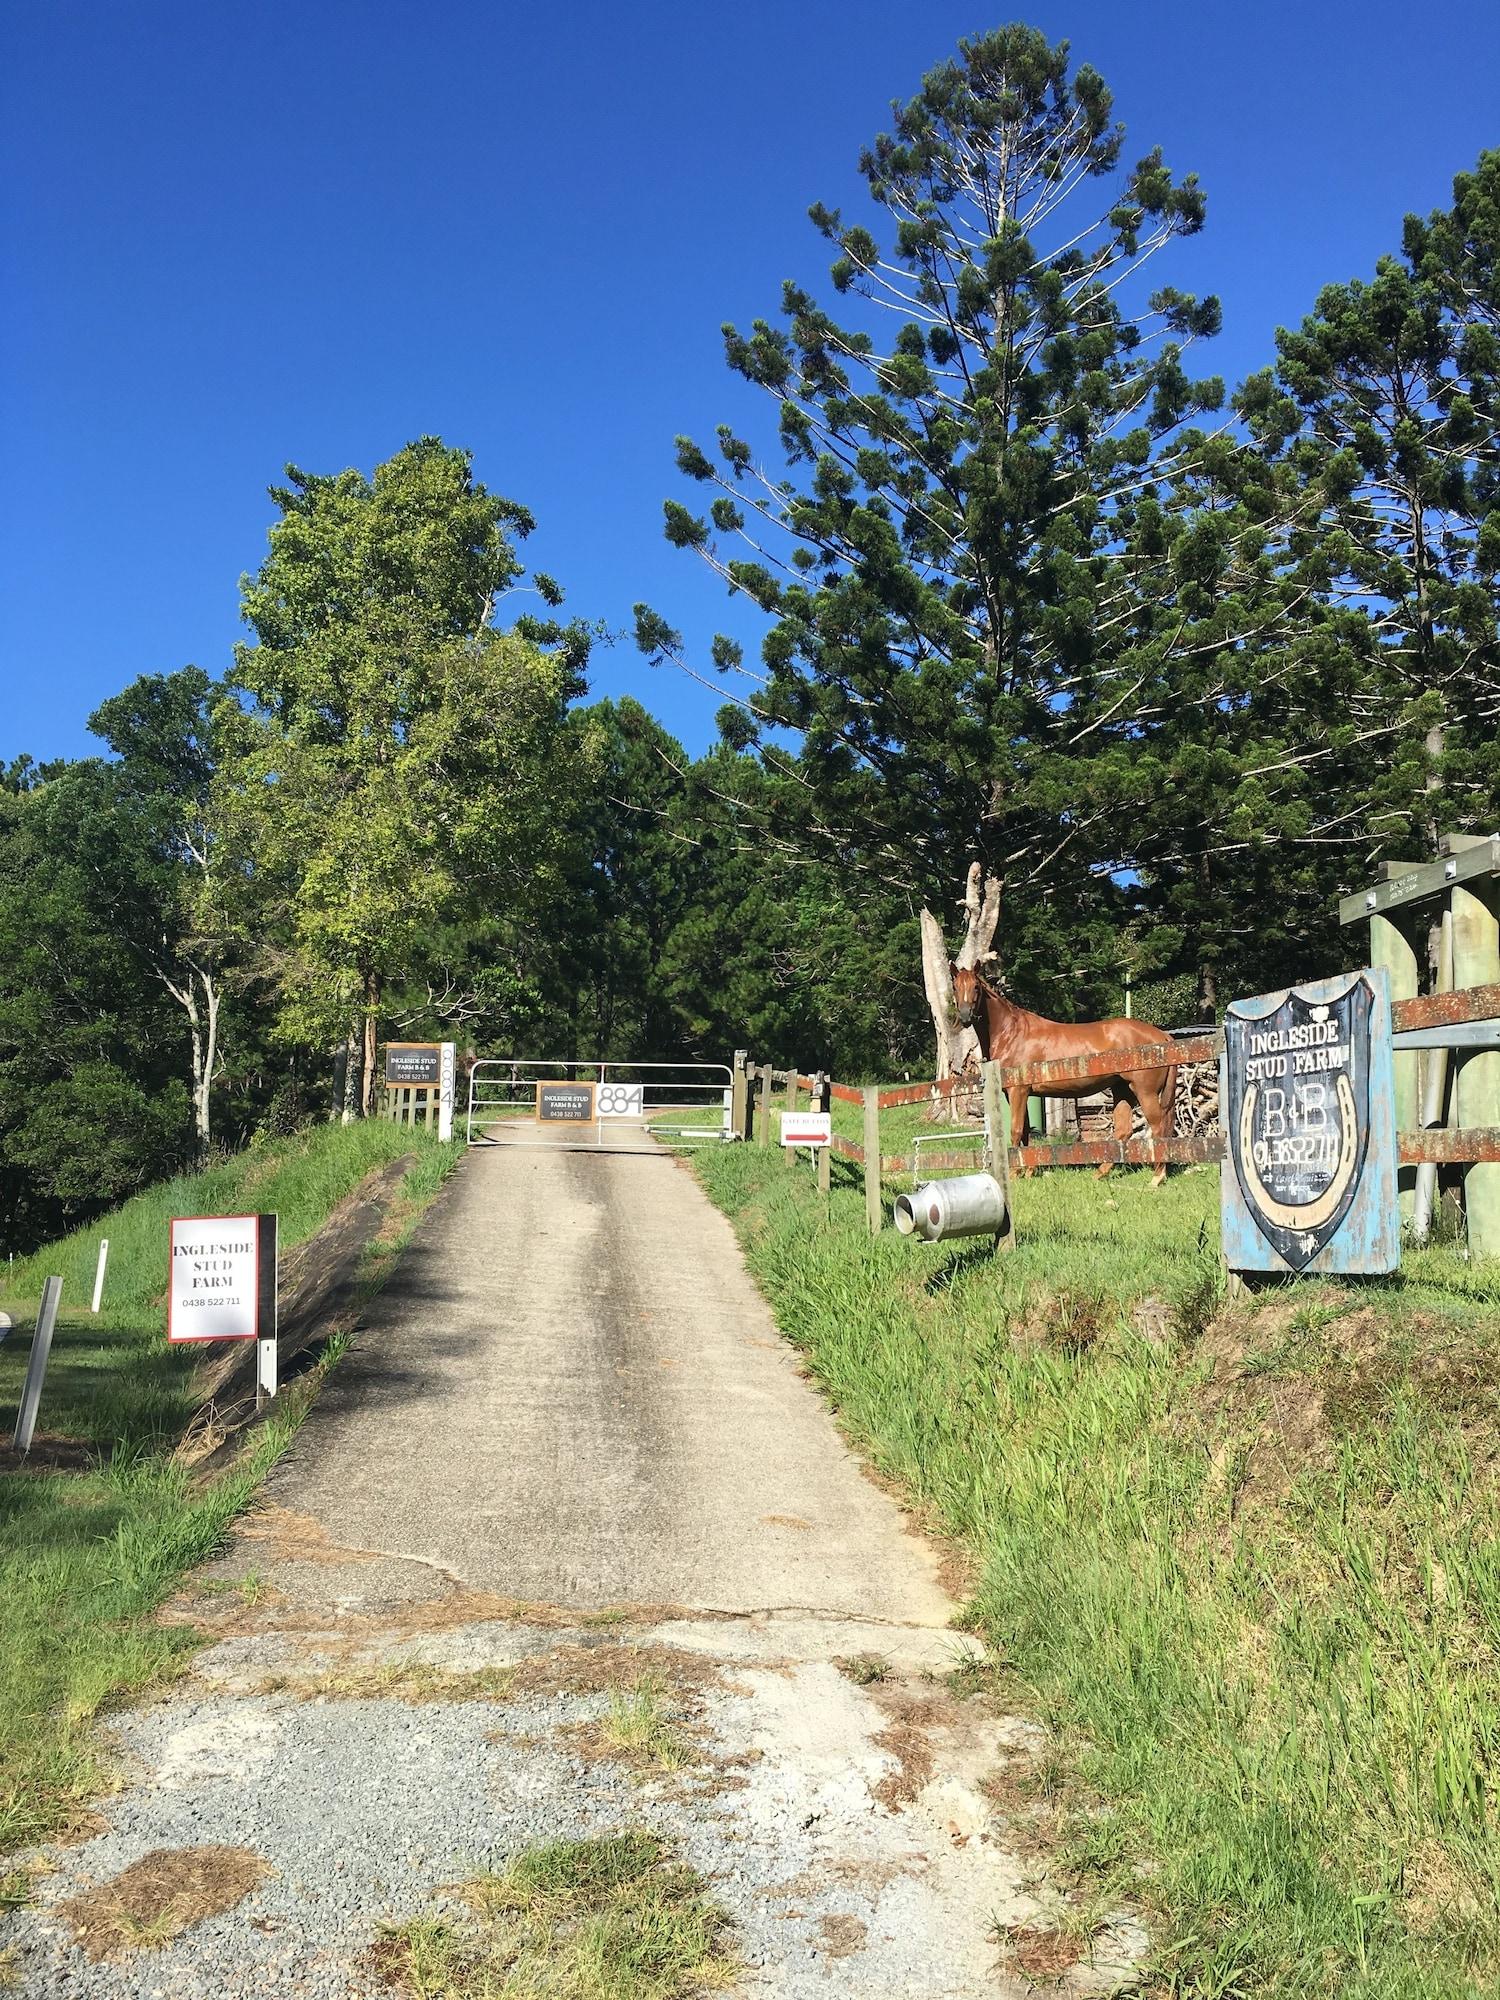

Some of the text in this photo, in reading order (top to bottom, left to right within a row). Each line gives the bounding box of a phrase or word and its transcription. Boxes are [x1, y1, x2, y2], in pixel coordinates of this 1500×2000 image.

[1250, 1019, 1339, 1056] INGLESIDE
[1246, 1055, 1287, 1081] STUD
[1293, 1045, 1343, 1074] FARM
[597, 1087, 642, 1114] 884
[173, 1242, 254, 1257] INGLESIDE
[193, 1260, 233, 1272] STUD
[192, 1276, 233, 1289] FARM
[182, 1297, 241, 1308] 0438 522 711
